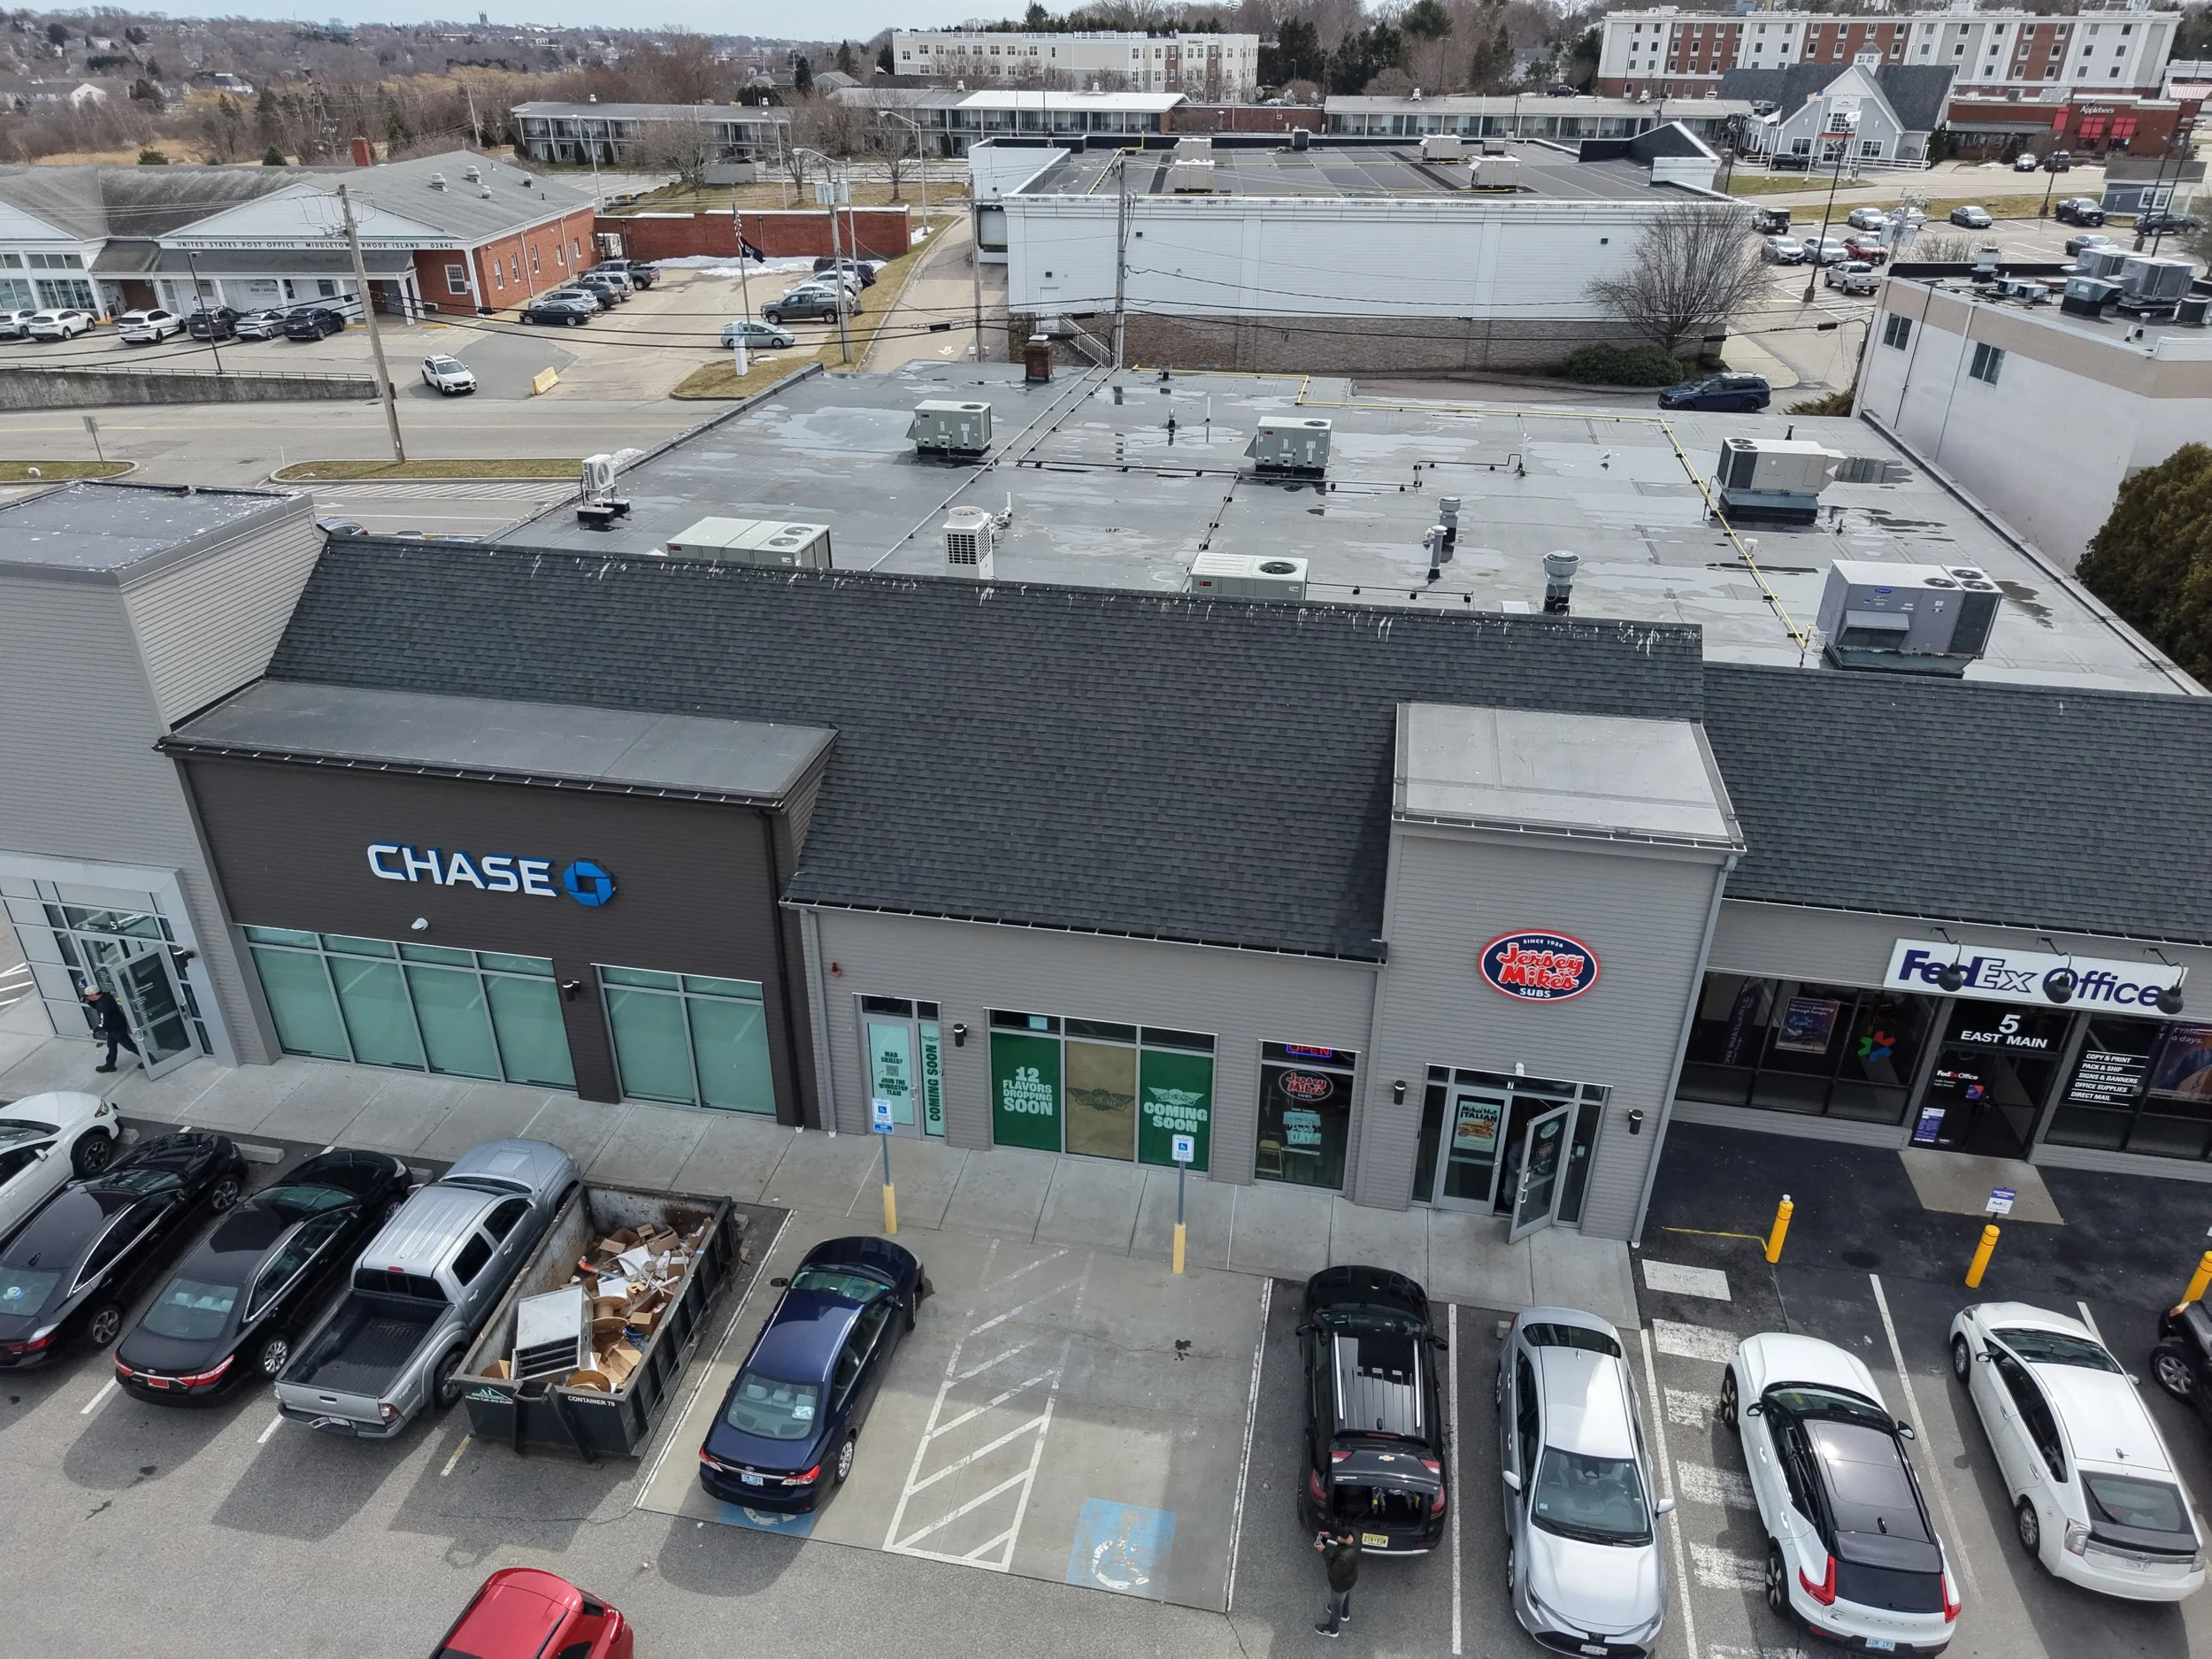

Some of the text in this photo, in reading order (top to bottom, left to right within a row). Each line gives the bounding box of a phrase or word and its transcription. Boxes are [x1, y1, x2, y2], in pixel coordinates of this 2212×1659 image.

[366, 841, 559, 897] CHASE
[110, 921, 117, 930] 5
[1547, 940, 1563, 949] 1956
[1496, 942, 1585, 977] Jersey
[1498, 964, 1579, 991] Mike's
[1898, 949, 2167, 1007] FedEx Office
[1519, 987, 1551, 998] SUBS
[1999, 1014, 2021, 1033] 5
[1960, 1030, 2048, 1048] EAST MAIN
[1288, 1044, 1330, 1055] OPEN
[926, 1044, 939, 1076] SOON
[2085, 1053, 2104, 1062] COPY
[880, 1077, 895, 1086] JOIN
[1015, 1066, 1040, 1083] 12
[1286, 1072, 1327, 1087] Jersey
[879, 1082, 909, 1092] WINGSTOP
[1002, 1079, 1053, 1094] FLAVORS
[2096, 1084, 2128, 1093] SUPPLIES
[927, 1079, 941, 1122] COMING
[1002, 1088, 1053, 1102] DROPPING
[1003, 1097, 1053, 1116] SOON
[1143, 1102, 1209, 1121] COMING
[1152, 1115, 1198, 1133] SOON
[1460, 1111, 1498, 1123] ITALIAN
[567, 1395, 606, 1406] CONTAINER
